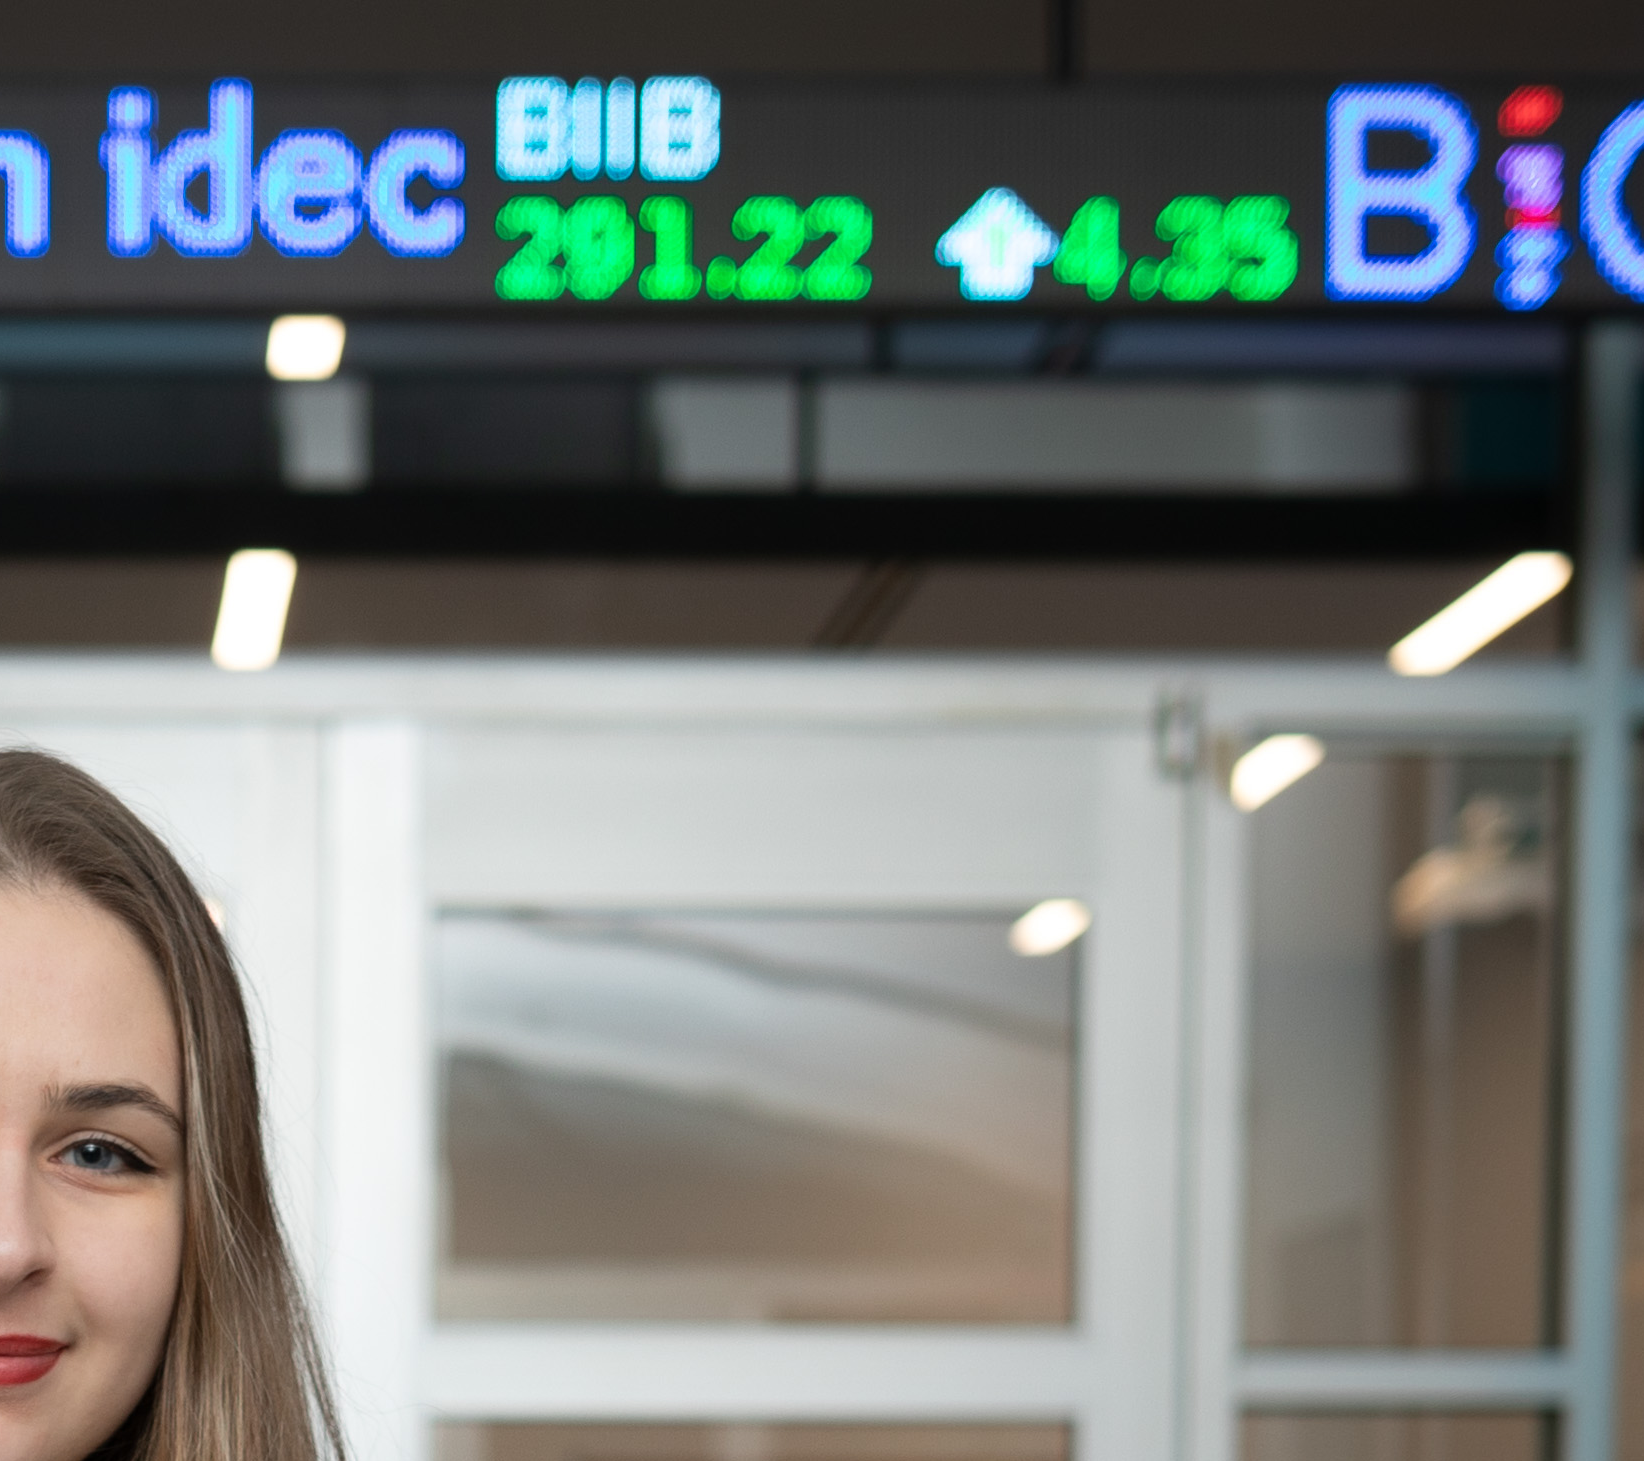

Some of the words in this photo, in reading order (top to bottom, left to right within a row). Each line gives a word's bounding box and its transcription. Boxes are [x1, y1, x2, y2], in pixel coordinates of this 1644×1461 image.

[99, 77, 466, 258] idec
[495, 76, 720, 182] BIIB
[495, 194, 873, 301] 291.22
[1053, 195, 1299, 302] 4.35
